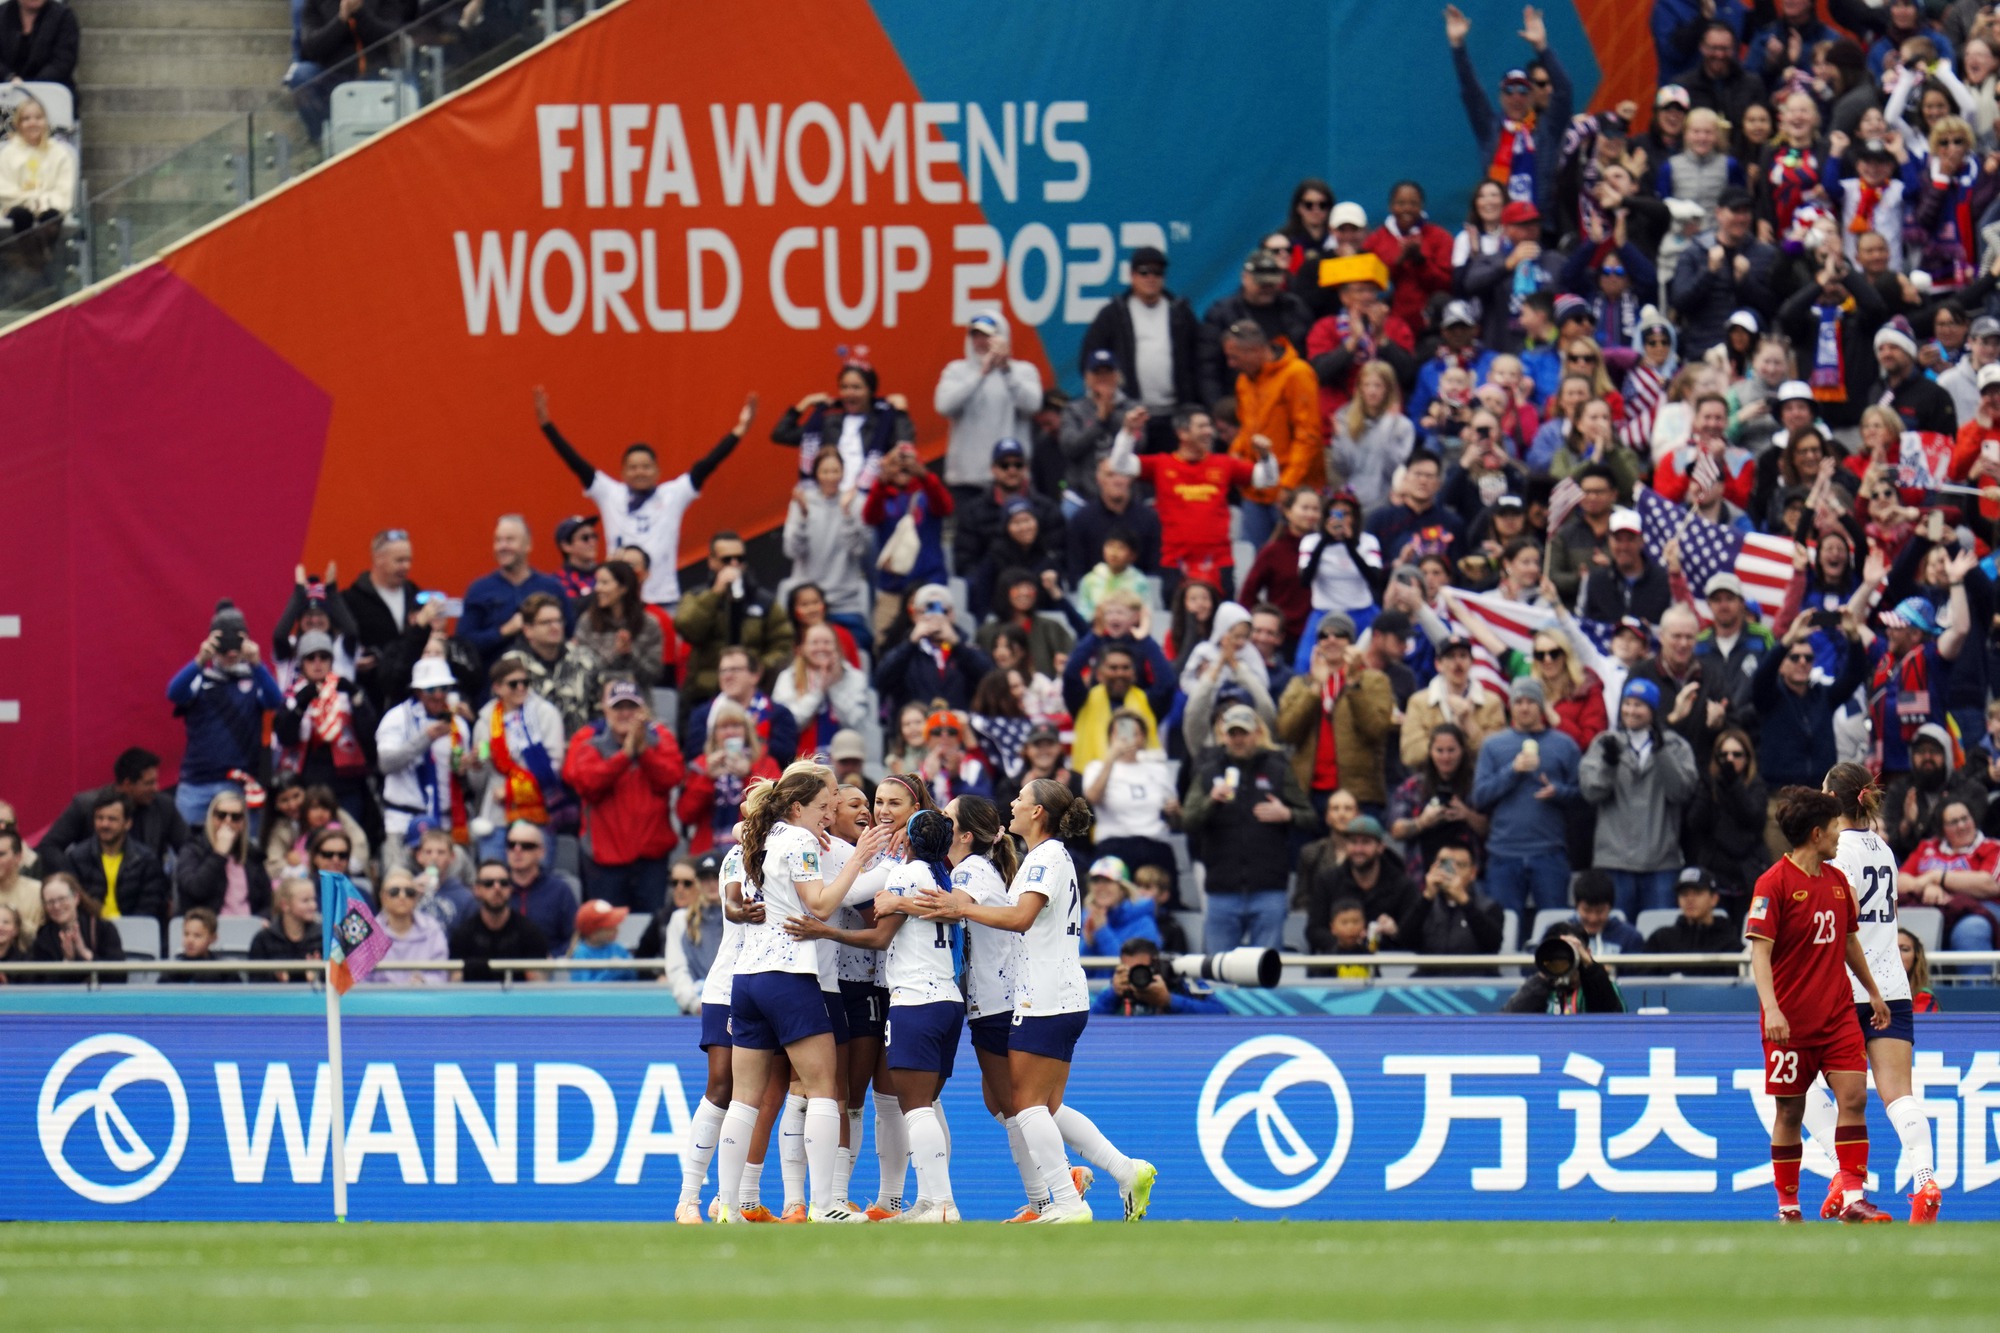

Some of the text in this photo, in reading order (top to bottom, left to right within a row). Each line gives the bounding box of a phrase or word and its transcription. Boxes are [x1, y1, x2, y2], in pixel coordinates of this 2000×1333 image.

[536, 100, 1092, 208] FIFA WOMEN'S
[453, 226, 743, 336] WORLD
[769, 224, 932, 329] CUP
[1861, 838, 1881, 851] FOX
[1857, 865, 1896, 923] 23
[1813, 909, 1836, 945] 23
[1769, 1049, 1799, 1084] 23
[213, 1062, 709, 1186] WANDA
